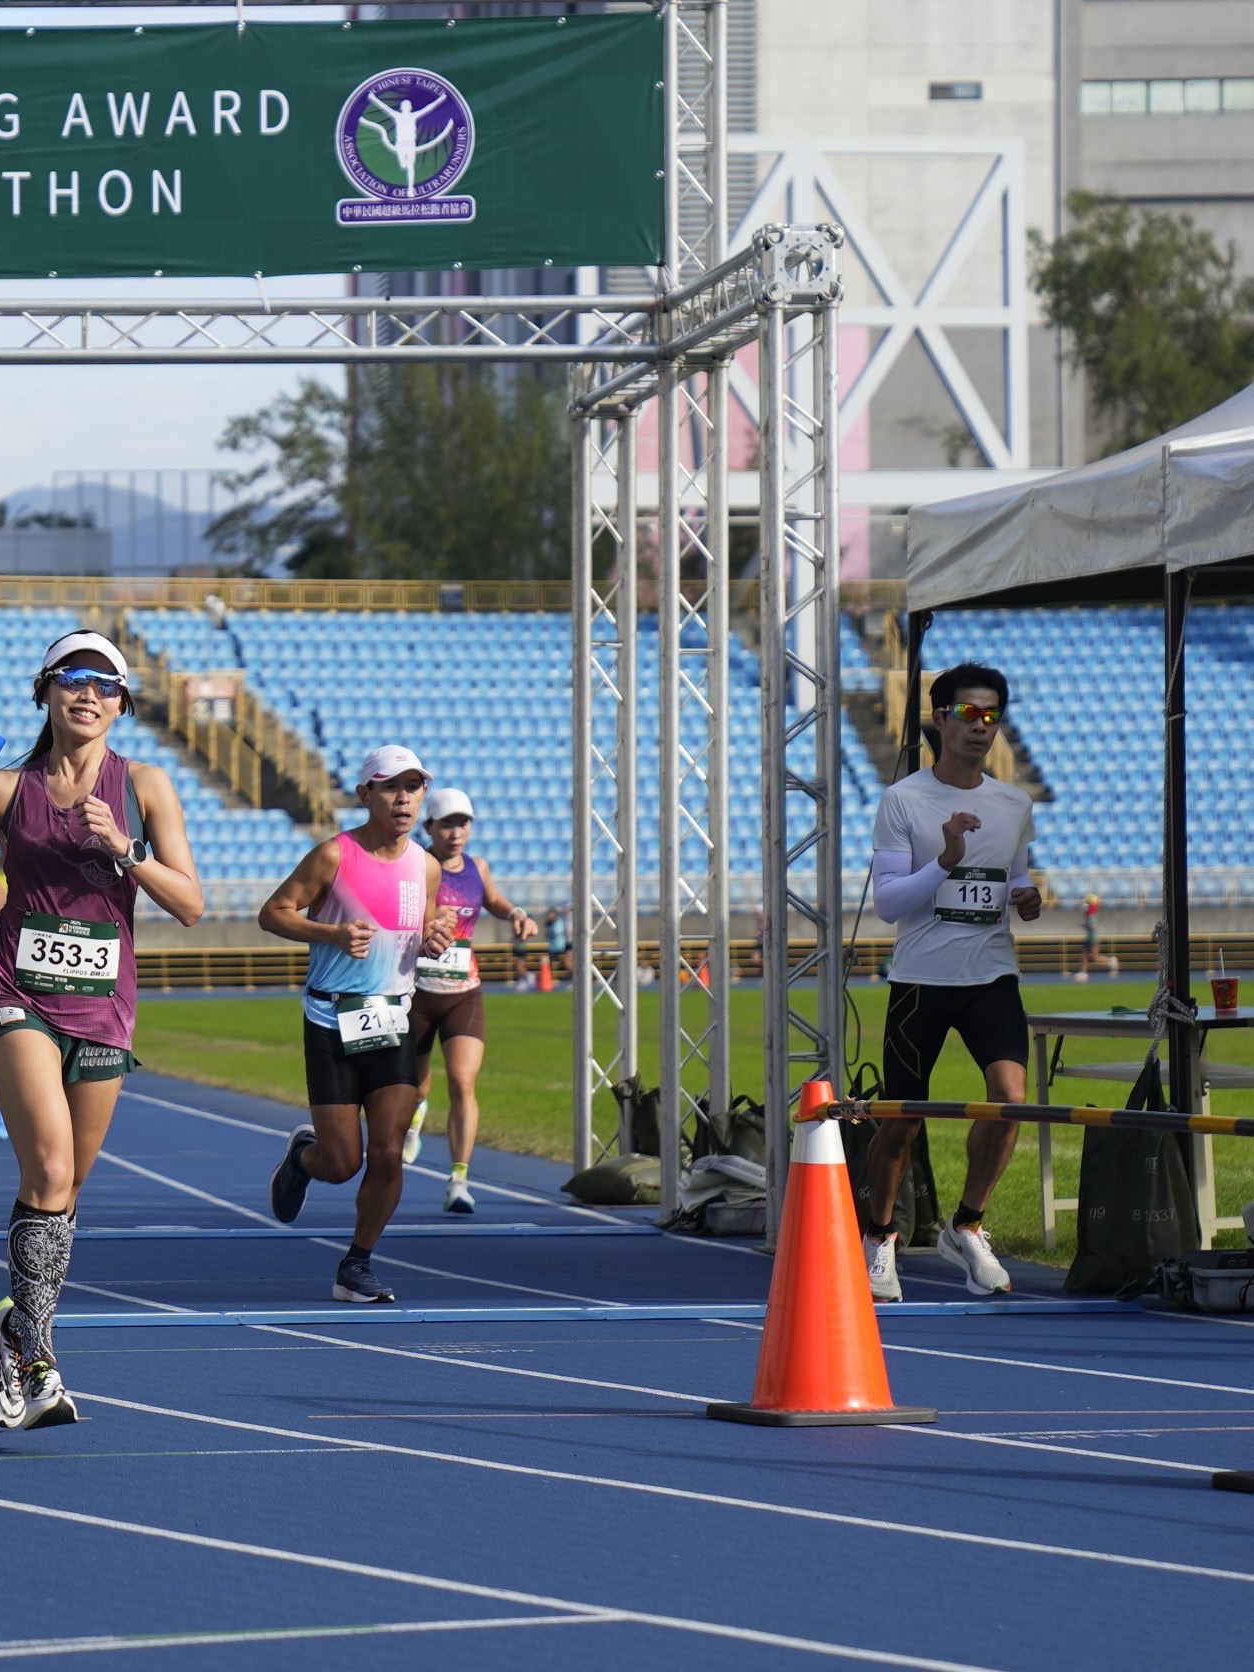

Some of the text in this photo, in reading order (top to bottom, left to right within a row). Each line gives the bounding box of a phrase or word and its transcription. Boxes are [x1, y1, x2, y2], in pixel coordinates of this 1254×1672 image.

[371, 76, 412, 93] CHINESE
[61, 89, 290, 137] AWARD
[344, 134, 389, 194] ASSOCIATION
[958, 884, 992, 904] 113
[30, 938, 109, 970] 353-3
